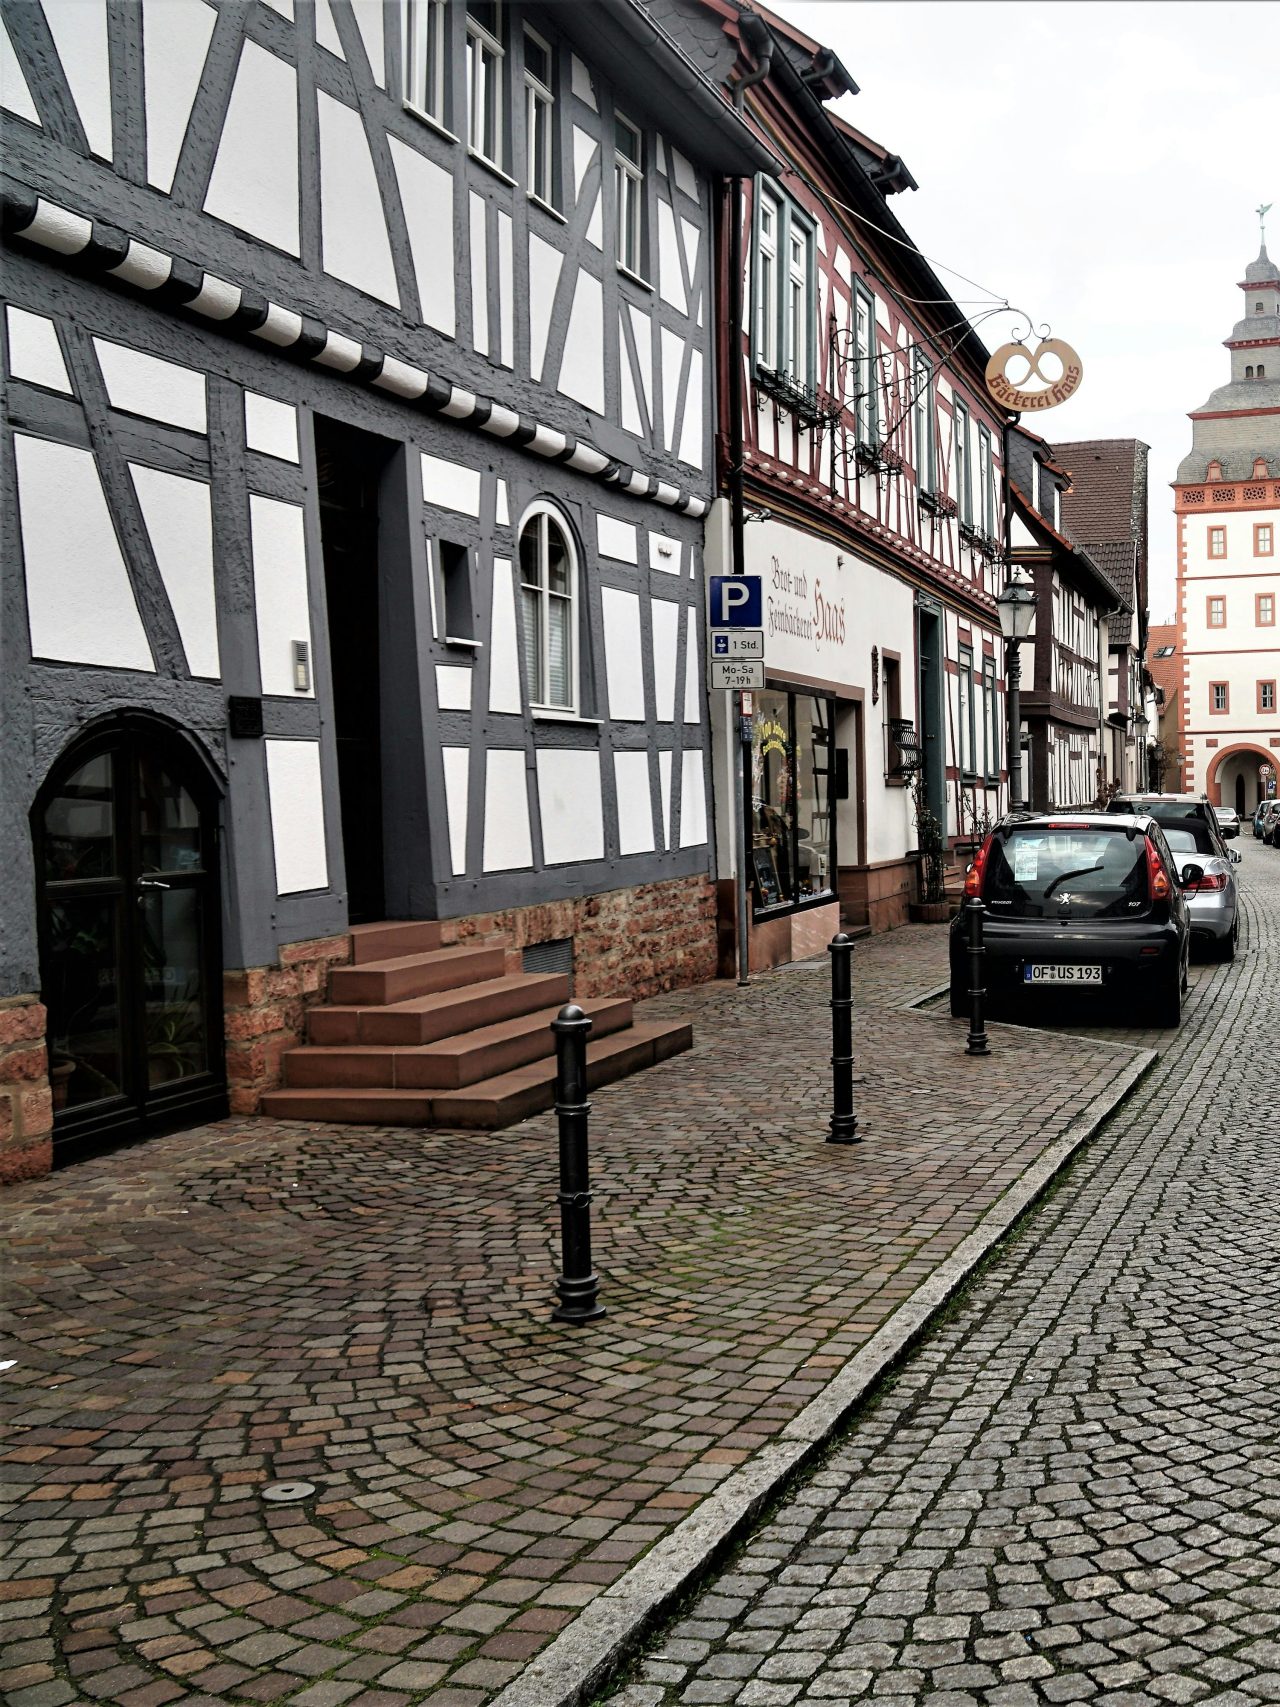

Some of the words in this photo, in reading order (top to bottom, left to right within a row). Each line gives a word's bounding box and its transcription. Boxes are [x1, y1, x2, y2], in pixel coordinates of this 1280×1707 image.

[987, 373, 1051, 408] Bäckerei
[1051, 365, 1080, 403] Haas
[721, 582, 750, 621] P
[794, 569, 808, 600] und
[767, 595, 813, 640] Feinbäckerei
[812, 577, 846, 652] Haas
[740, 641, 759, 649] Std.
[722, 665, 754, 674] Mo-Sa
[1033, 966, 1049, 979] OF
[1057, 967, 1074, 979] US
[1077, 967, 1100, 980] 193
